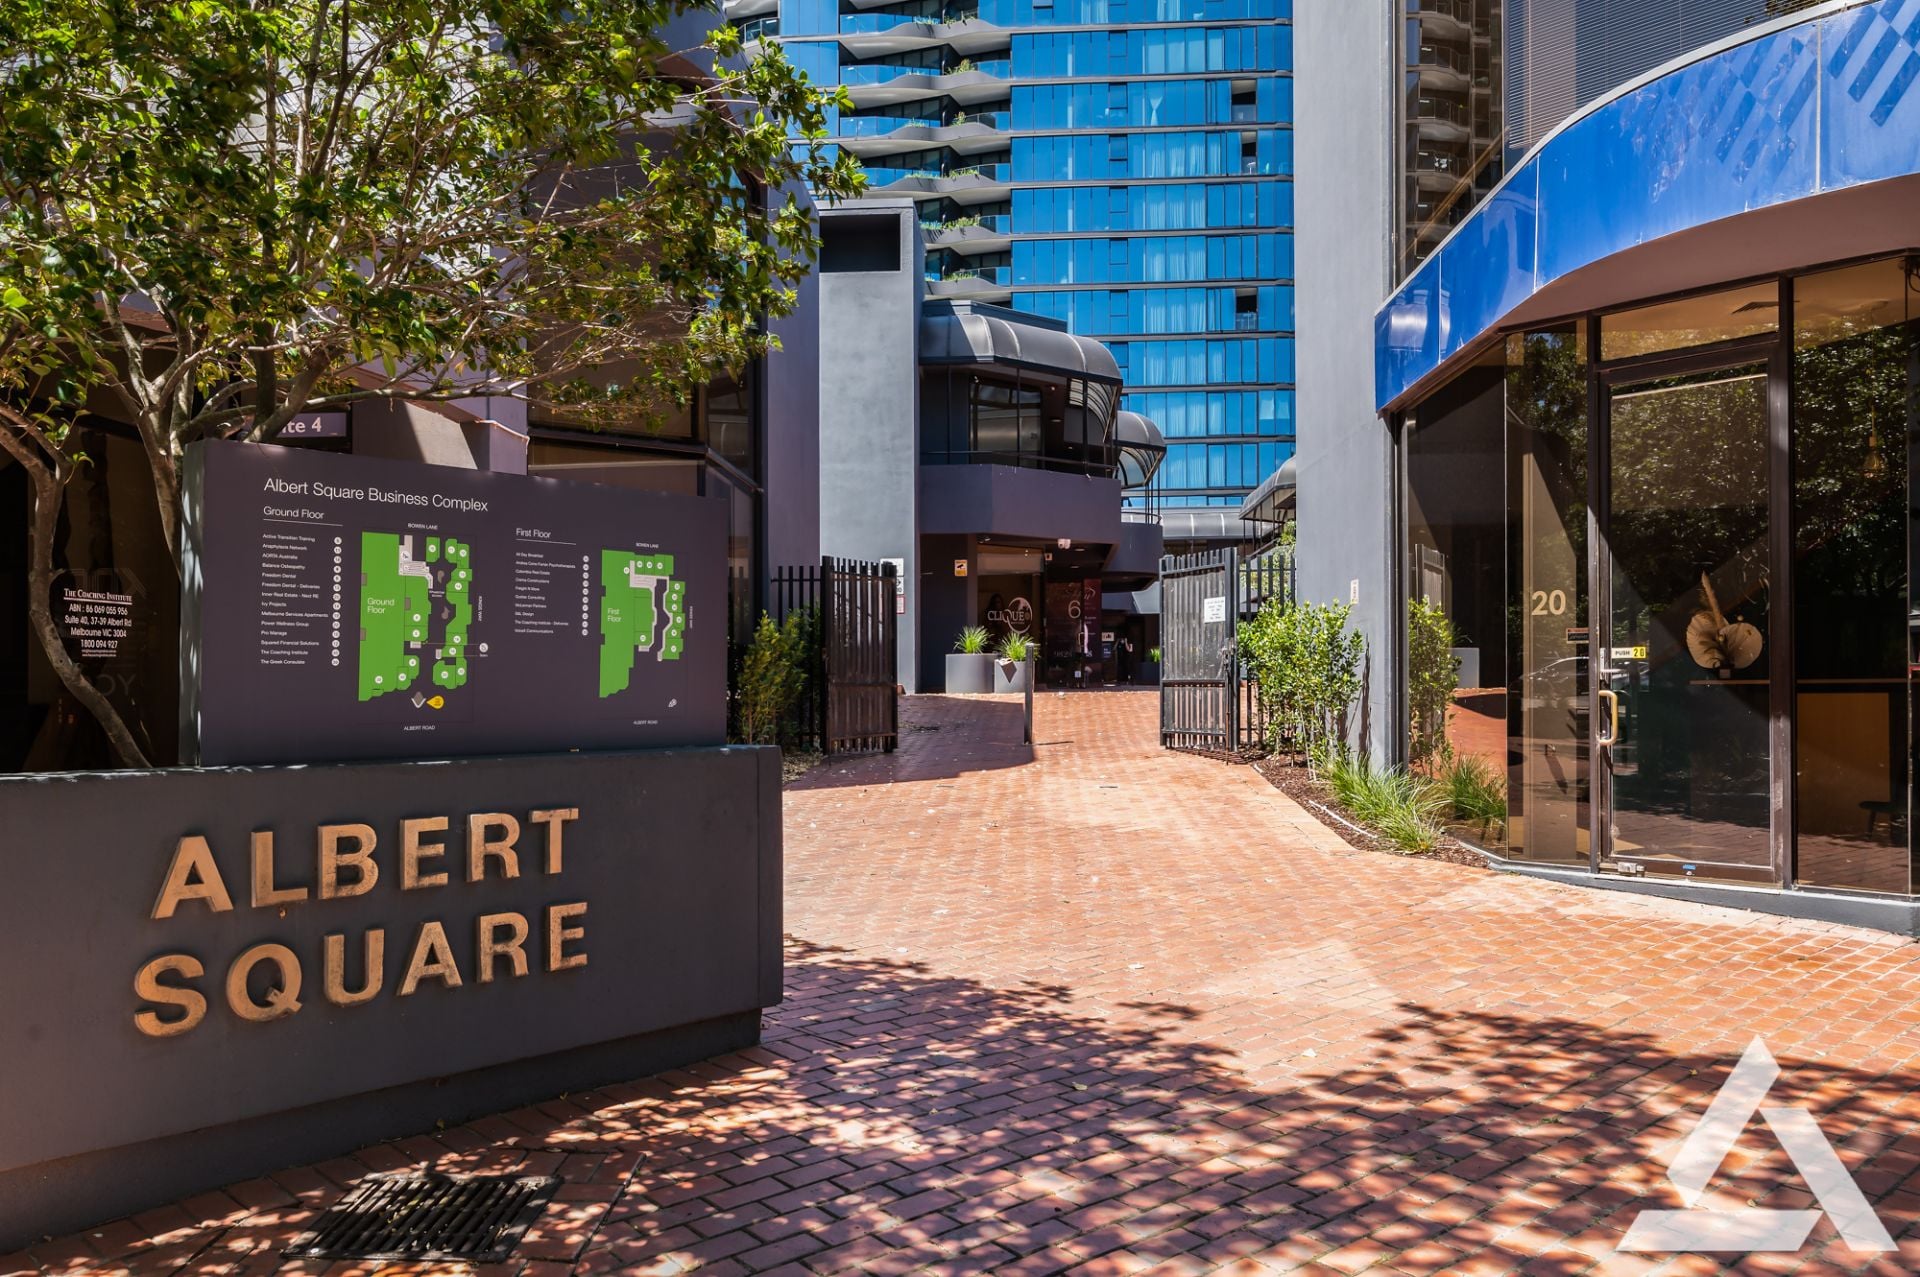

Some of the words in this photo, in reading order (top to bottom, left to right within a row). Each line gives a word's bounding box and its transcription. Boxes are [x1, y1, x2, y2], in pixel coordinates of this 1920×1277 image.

[312, 416, 322, 432] 4
[264, 478, 308, 495] Albert
[312, 482, 364, 500] Square
[368, 488, 428, 506] Business
[432, 494, 488, 512] Complex
[263, 506, 299, 518] Ground
[302, 508, 324, 519] Floor
[516, 528, 532, 537] First
[533, 529, 552, 538] Floor
[64, 588, 76, 597] THE
[77, 589, 106, 600] COACHING
[106, 592, 132, 602] INSTITUTE
[367, 598, 395, 606] Ground
[1531, 589, 1566, 616] 20
[69, 603, 81, 612] ABN
[86, 604, 93, 613] 86
[94, 605, 105, 614] 069
[106, 606, 116, 614] 055
[117, 607, 128, 615] 956
[367, 606, 385, 614] Floor
[988, 609, 1025, 622] CLIQUE
[1068, 600, 1081, 619] 6
[65, 615, 79, 624] Suite
[90, 616, 107, 626] 37-39
[108, 618, 123, 626] Albert
[124, 619, 132, 627] Rd
[71, 626, 101, 636] Melbourne
[102, 628, 112, 637] VIC
[113, 629, 127, 638] 3004
[81, 639, 95, 648] 1800
[96, 640, 107, 648] 094
[107, 640, 118, 649] 927
[150, 807, 580, 919] ALBERT
[134, 902, 588, 1038] SQUARE
